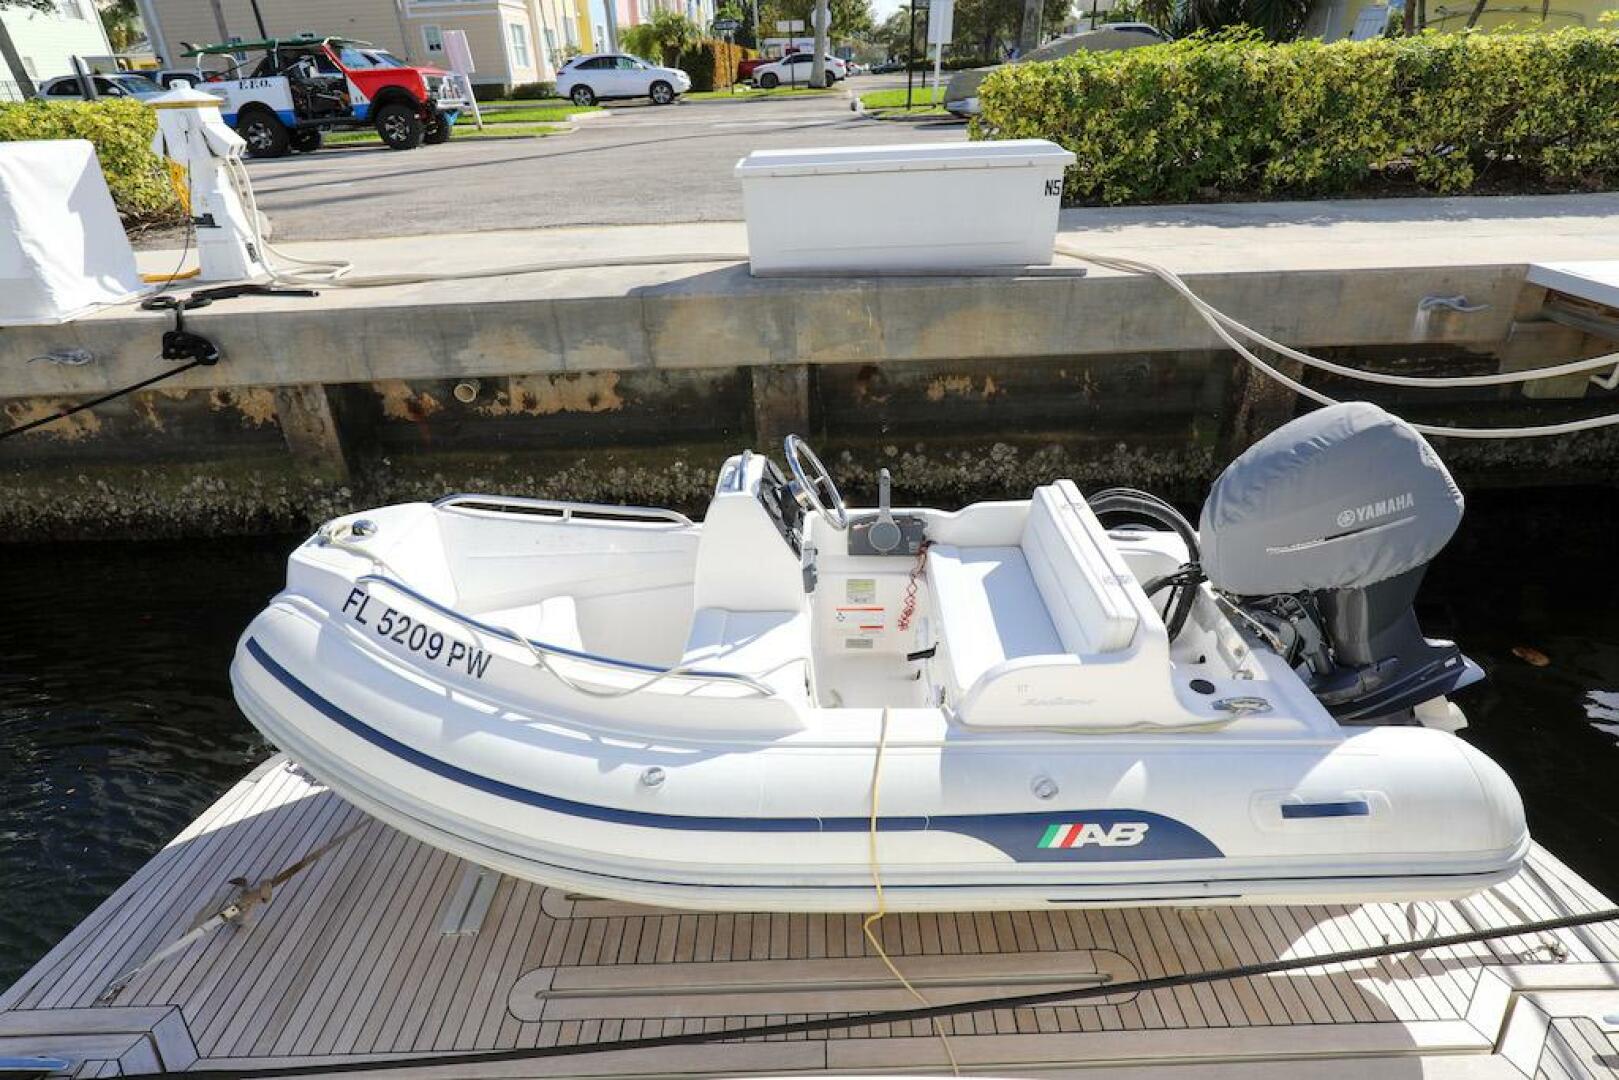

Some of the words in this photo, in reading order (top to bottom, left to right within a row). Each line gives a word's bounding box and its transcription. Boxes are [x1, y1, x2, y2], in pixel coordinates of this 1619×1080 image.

[1045, 179, 1061, 196] N5
[1356, 493, 1415, 522] YAMAHA
[342, 587, 371, 625] FL
[377, 608, 444, 660] 5209
[446, 641, 493, 679] PW
[1070, 823, 1149, 848] AB
